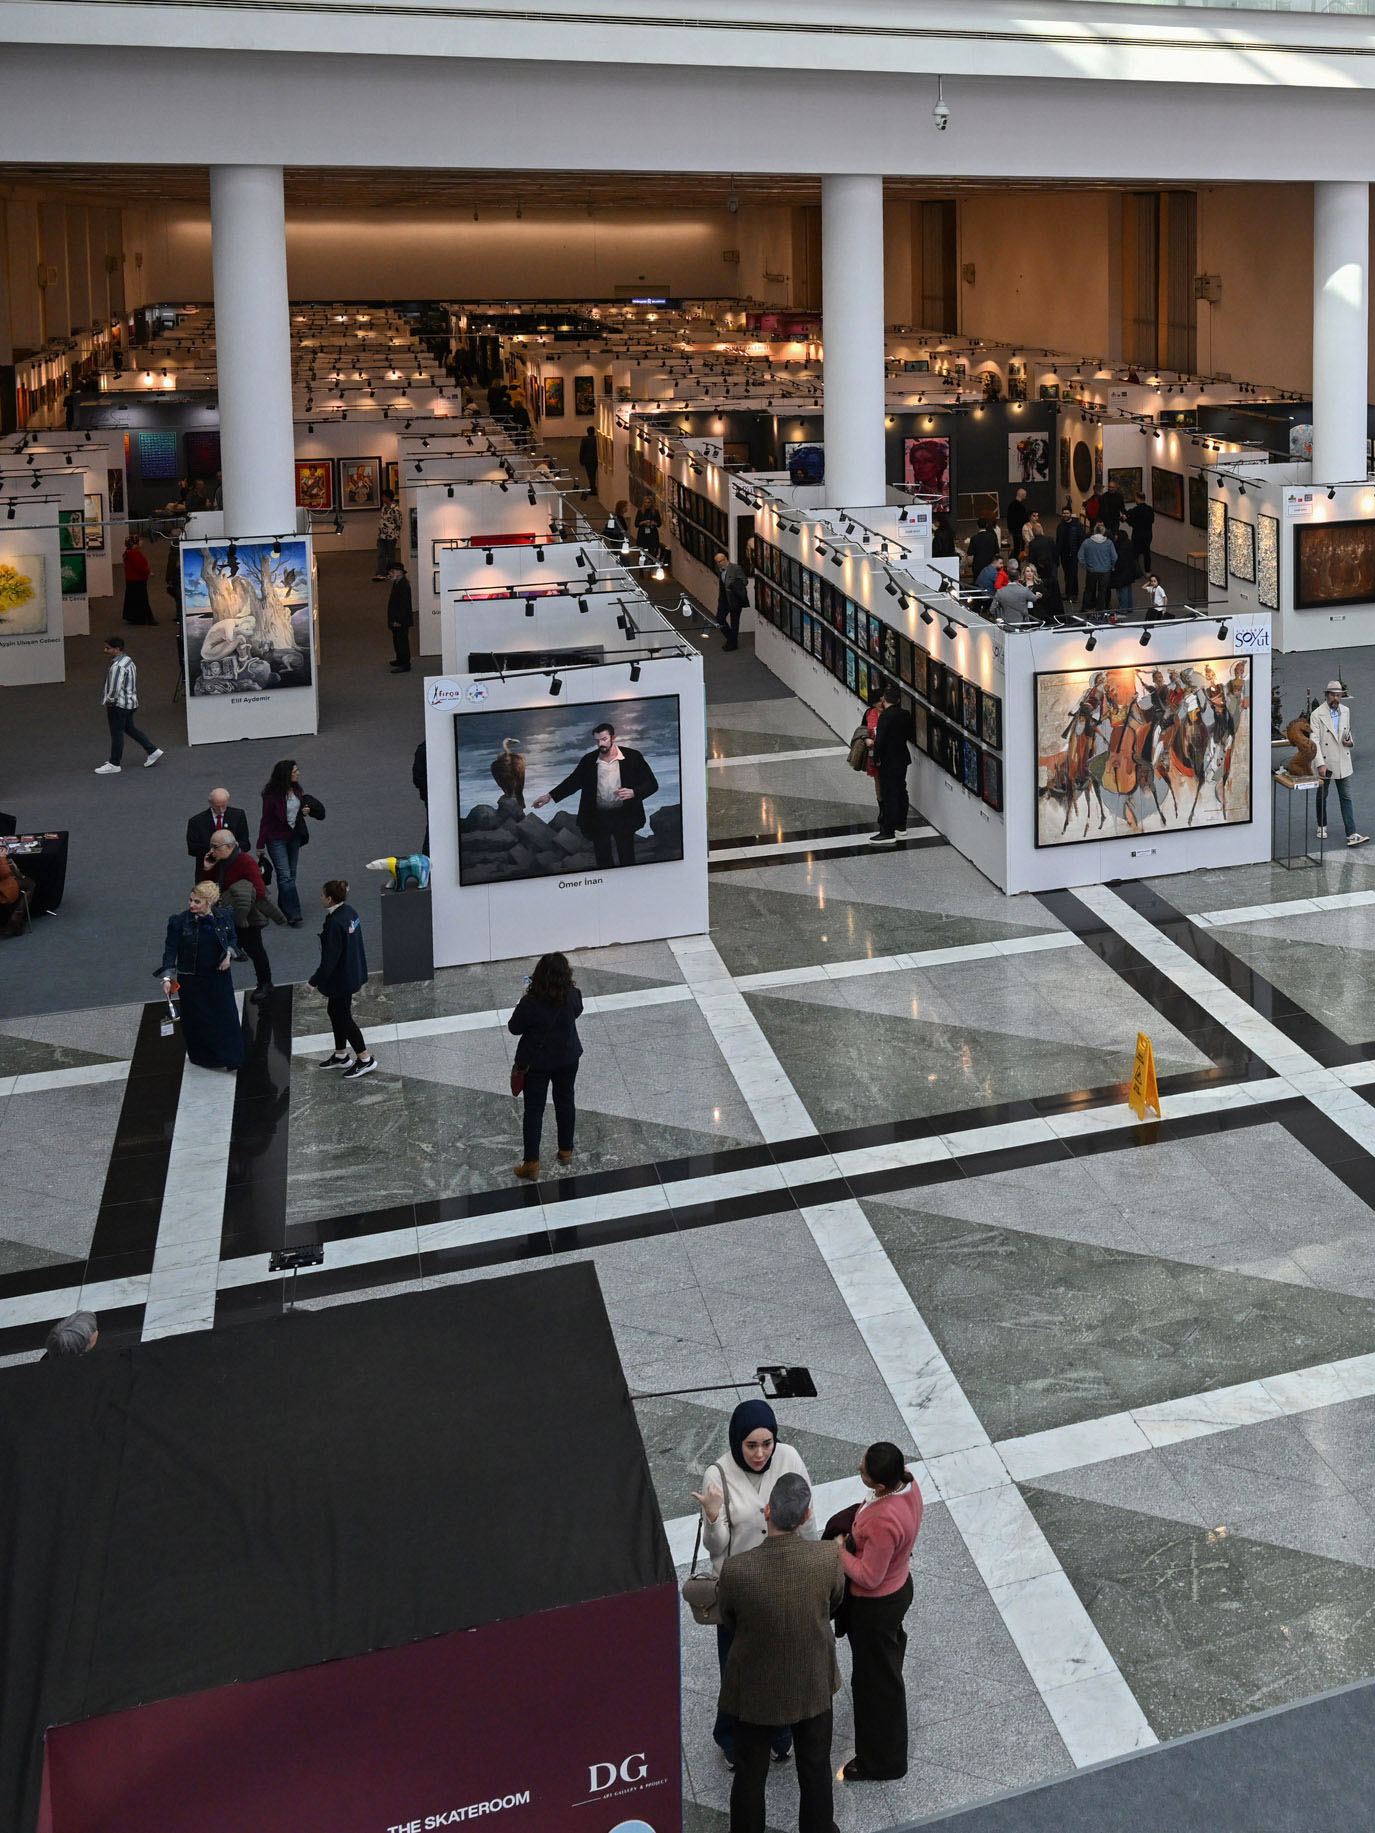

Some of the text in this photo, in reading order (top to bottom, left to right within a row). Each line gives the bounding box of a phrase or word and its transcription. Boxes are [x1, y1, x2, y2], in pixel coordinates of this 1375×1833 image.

[243, 695, 271, 704] Aydemir
[558, 876, 604, 889] Ömer İnan
[588, 1752, 648, 1793] DG
[387, 1790, 532, 1833] THE SKATEROOM
